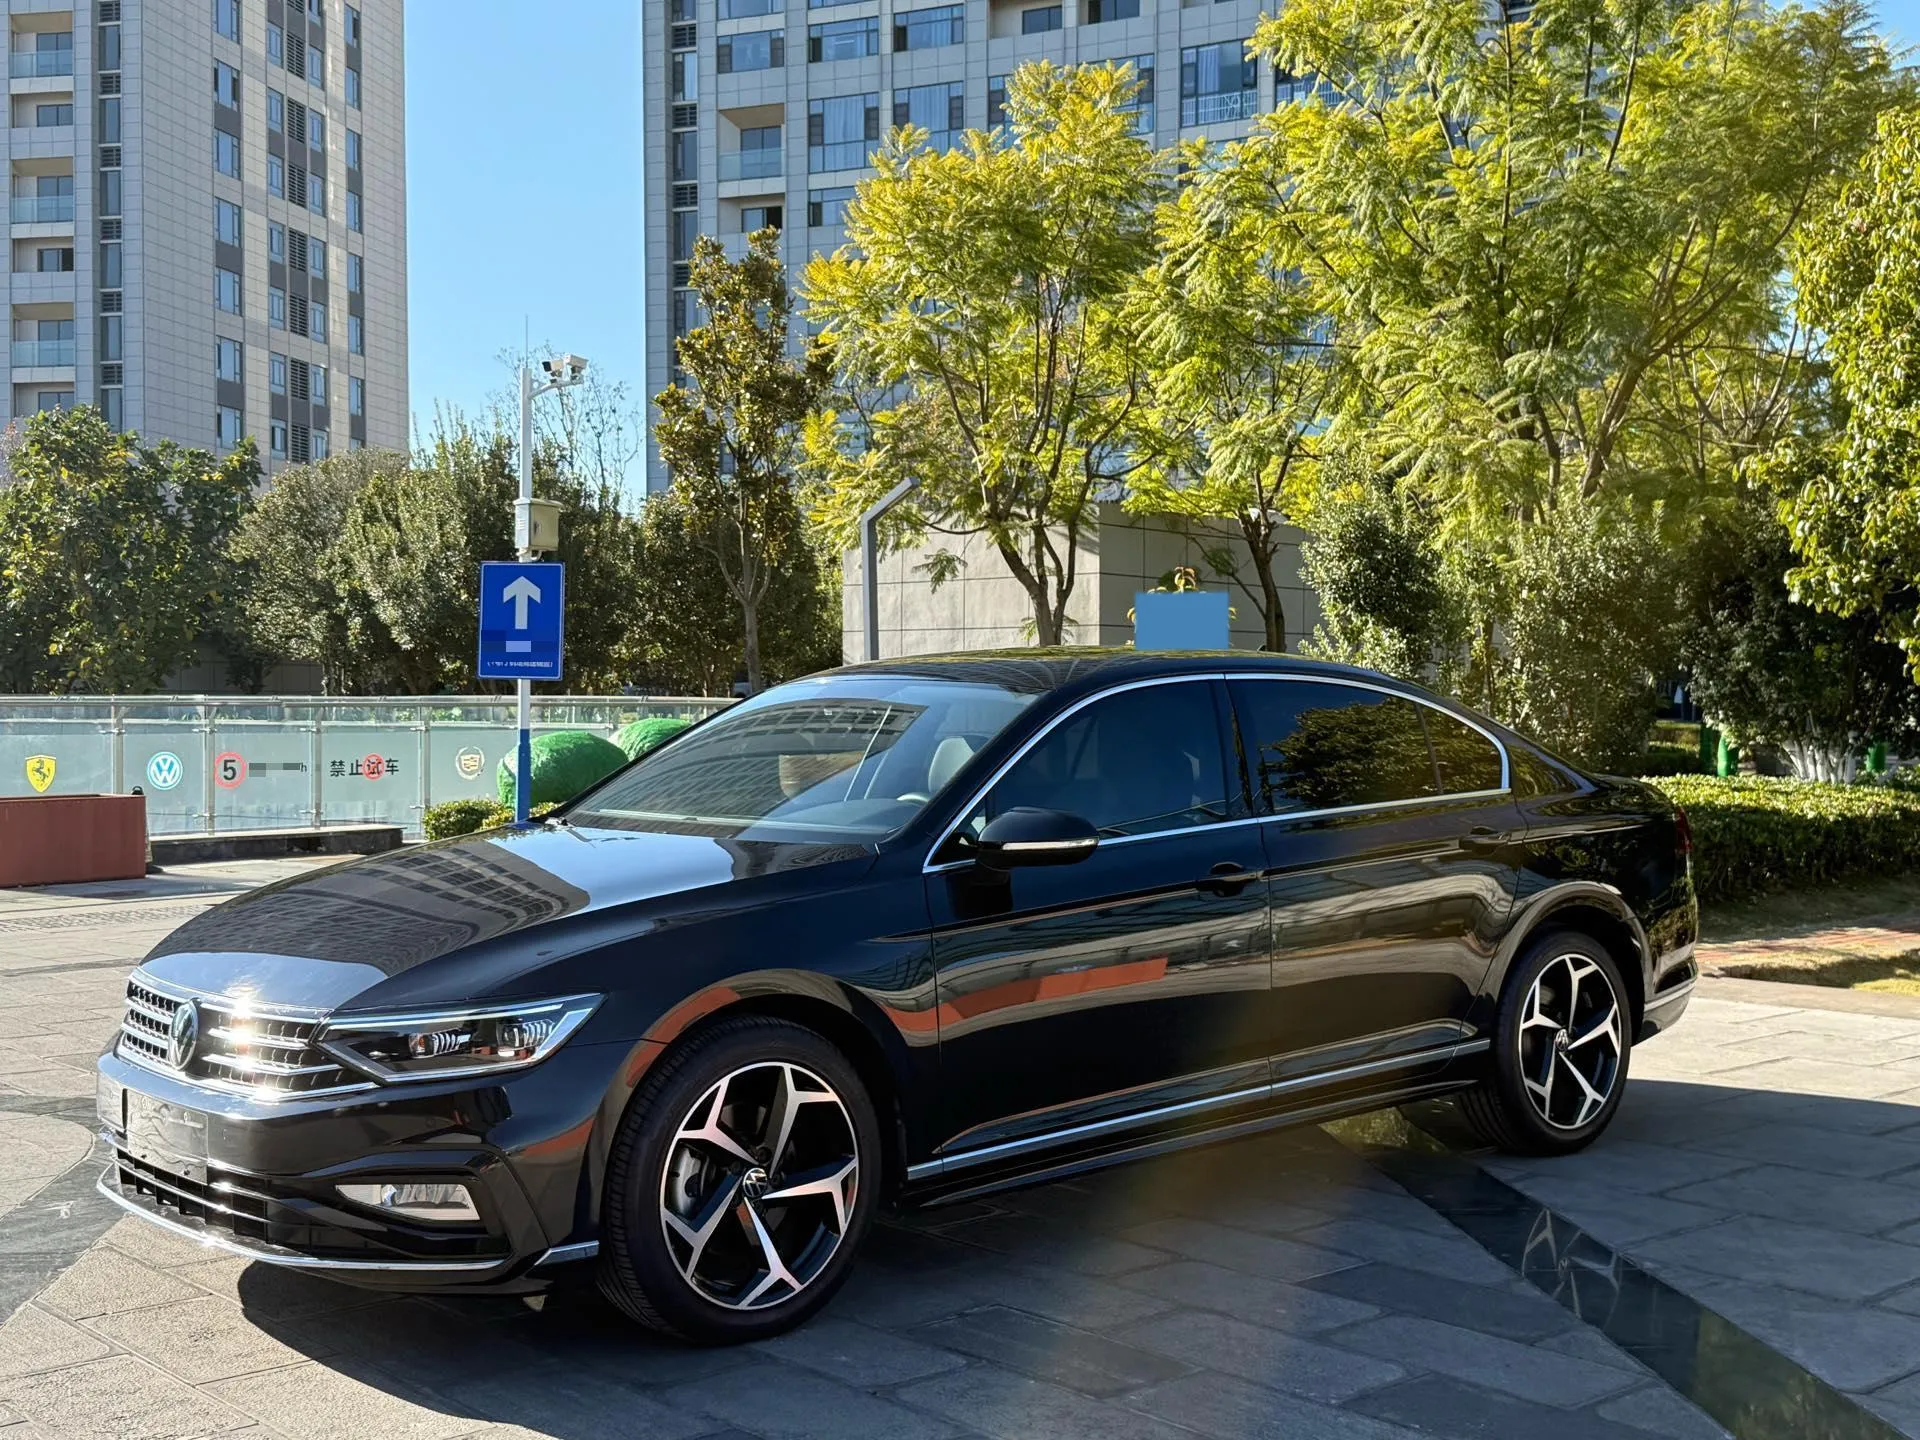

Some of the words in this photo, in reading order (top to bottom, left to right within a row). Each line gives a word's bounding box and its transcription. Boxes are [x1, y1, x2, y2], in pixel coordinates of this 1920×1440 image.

[222, 759, 237, 780] 5
[329, 758, 399, 777] 禁止试车
